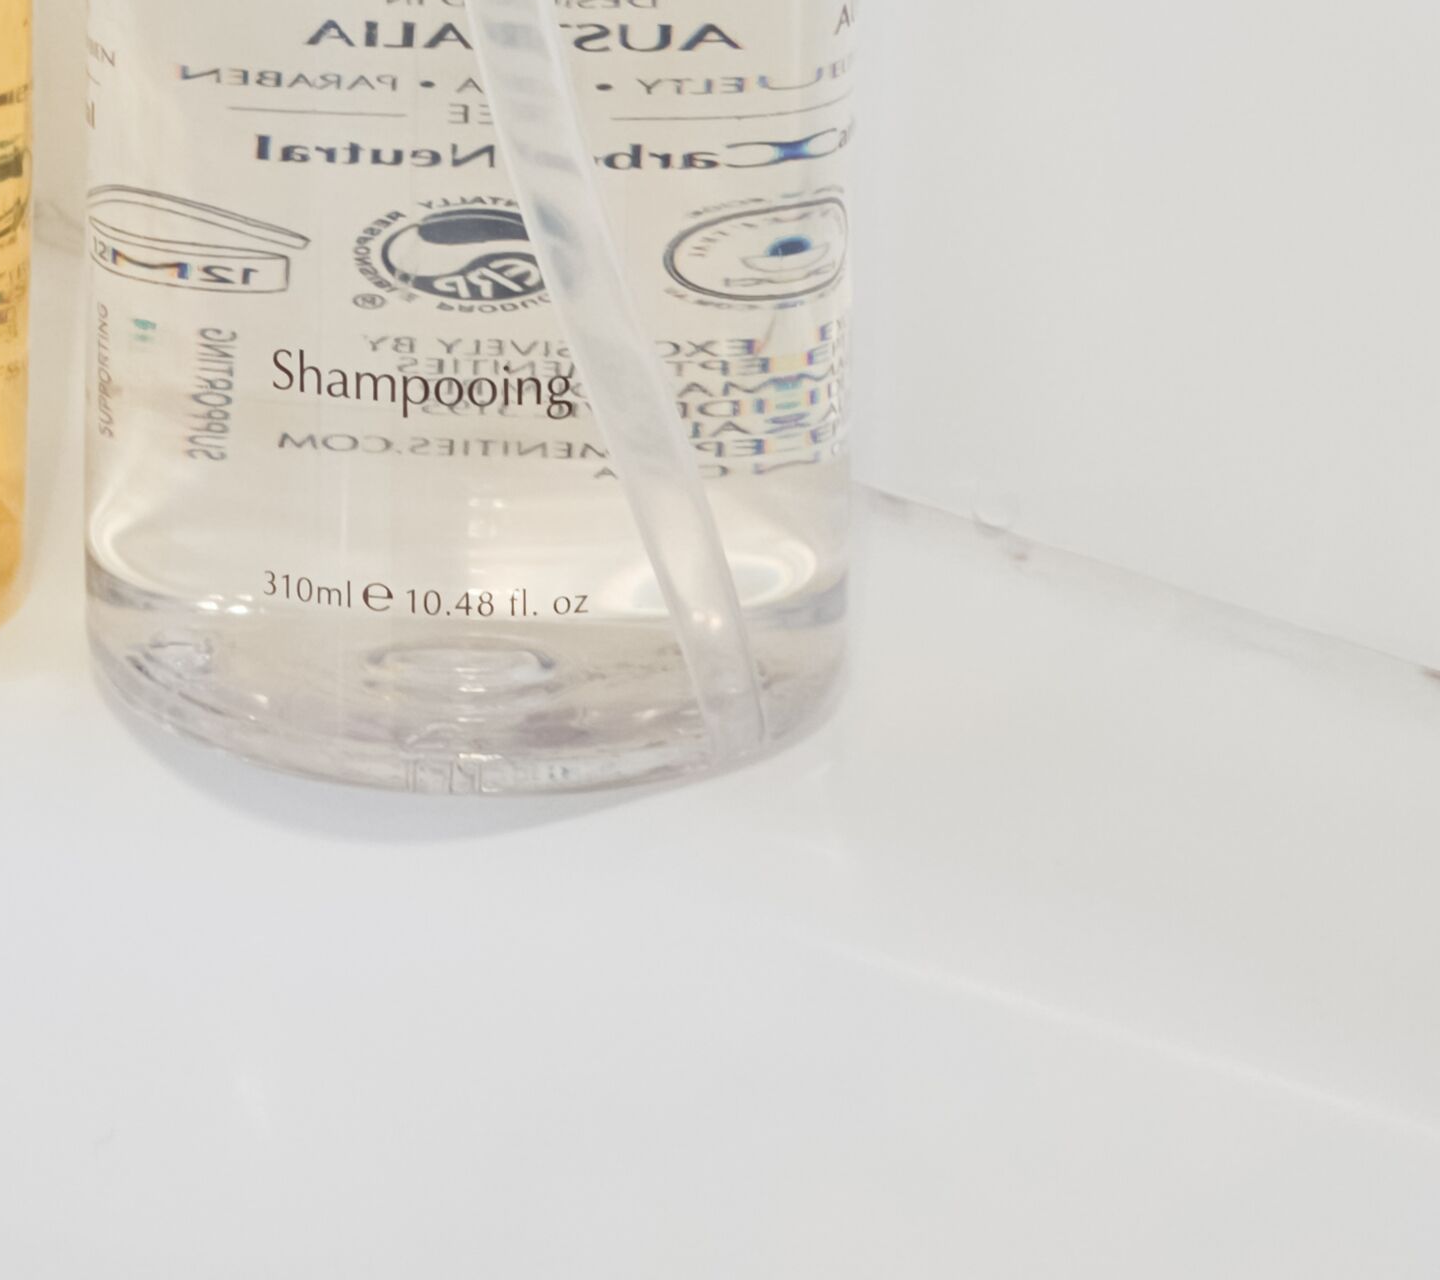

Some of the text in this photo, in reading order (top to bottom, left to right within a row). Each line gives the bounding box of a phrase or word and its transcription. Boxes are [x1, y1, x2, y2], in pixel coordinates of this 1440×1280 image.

[271, 348, 575, 420] Shampooing
[263, 570, 352, 608] 310ml
[406, 589, 495, 617] 10.48
[509, 588, 538, 617] fl.
[553, 594, 589, 615] oz
